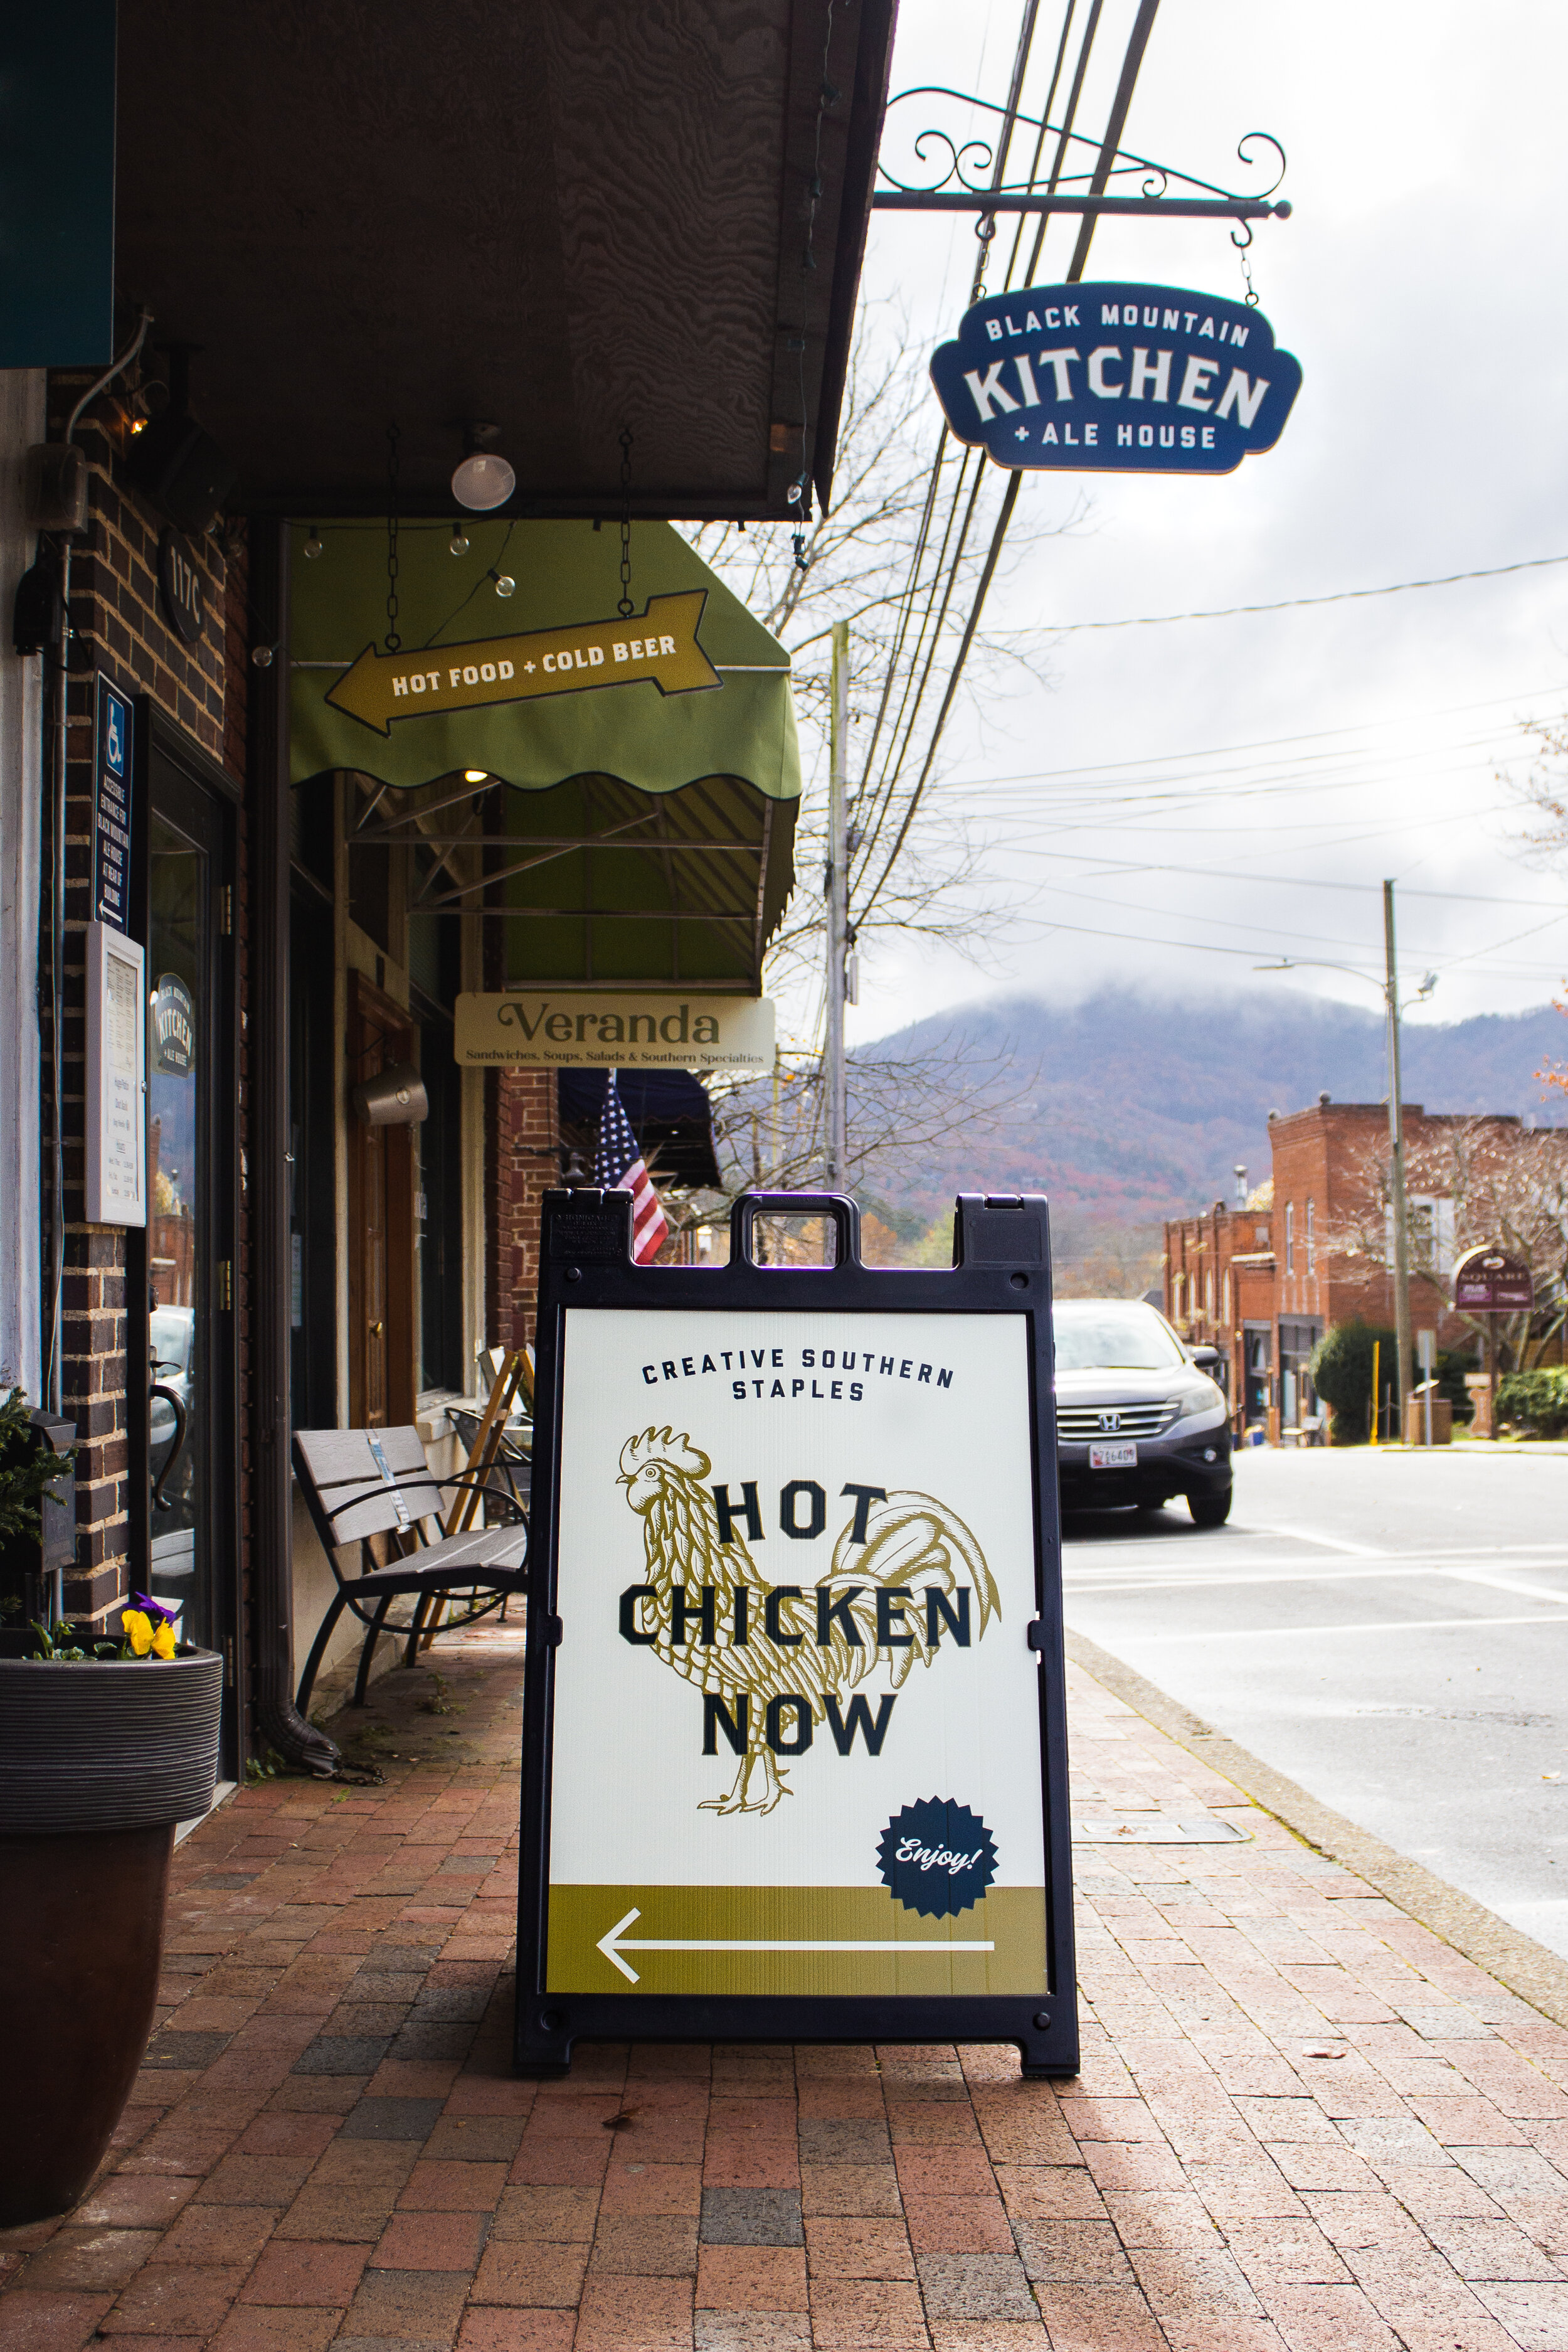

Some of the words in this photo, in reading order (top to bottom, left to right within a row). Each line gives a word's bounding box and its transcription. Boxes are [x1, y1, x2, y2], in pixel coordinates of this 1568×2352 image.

[986, 305, 1079, 341] BLACK
[1102, 304, 1249, 348] MOUNTAIN
[965, 346, 1270, 429] KITCHEN
[1015, 427, 1029, 441] +
[1042, 423, 1098, 445] ALE
[1118, 424, 1215, 449] HOUSE
[171, 545, 200, 624] 117C
[392, 671, 440, 696] HOT
[448, 661, 514, 687] FOOD
[524, 661, 536, 673] +
[543, 646, 605, 673] COLD
[612, 636, 676, 663] BEER
[159, 1008, 192, 1056] KITCHEN
[497, 1002, 719, 1044] Veranda
[466, 1050, 540, 1062] Sandwiches,
[543, 1050, 583, 1063] Soups,
[586, 1051, 625, 1062] Salads
[628, 1051, 637, 1062] &
[641, 1052, 696, 1063] Southern
[700, 1052, 764, 1065] Specialties
[642, 1349, 783, 1385] CREATIVE
[802, 1349, 953, 1388] SOUTHERN
[733, 1380, 864, 1402] STAPLES
[711, 1480, 888, 1544] HOT
[618, 1585, 972, 1648] CHICKEN
[702, 1693, 898, 1756] NOW
[896, 1837, 983, 1875] Enjoy!
